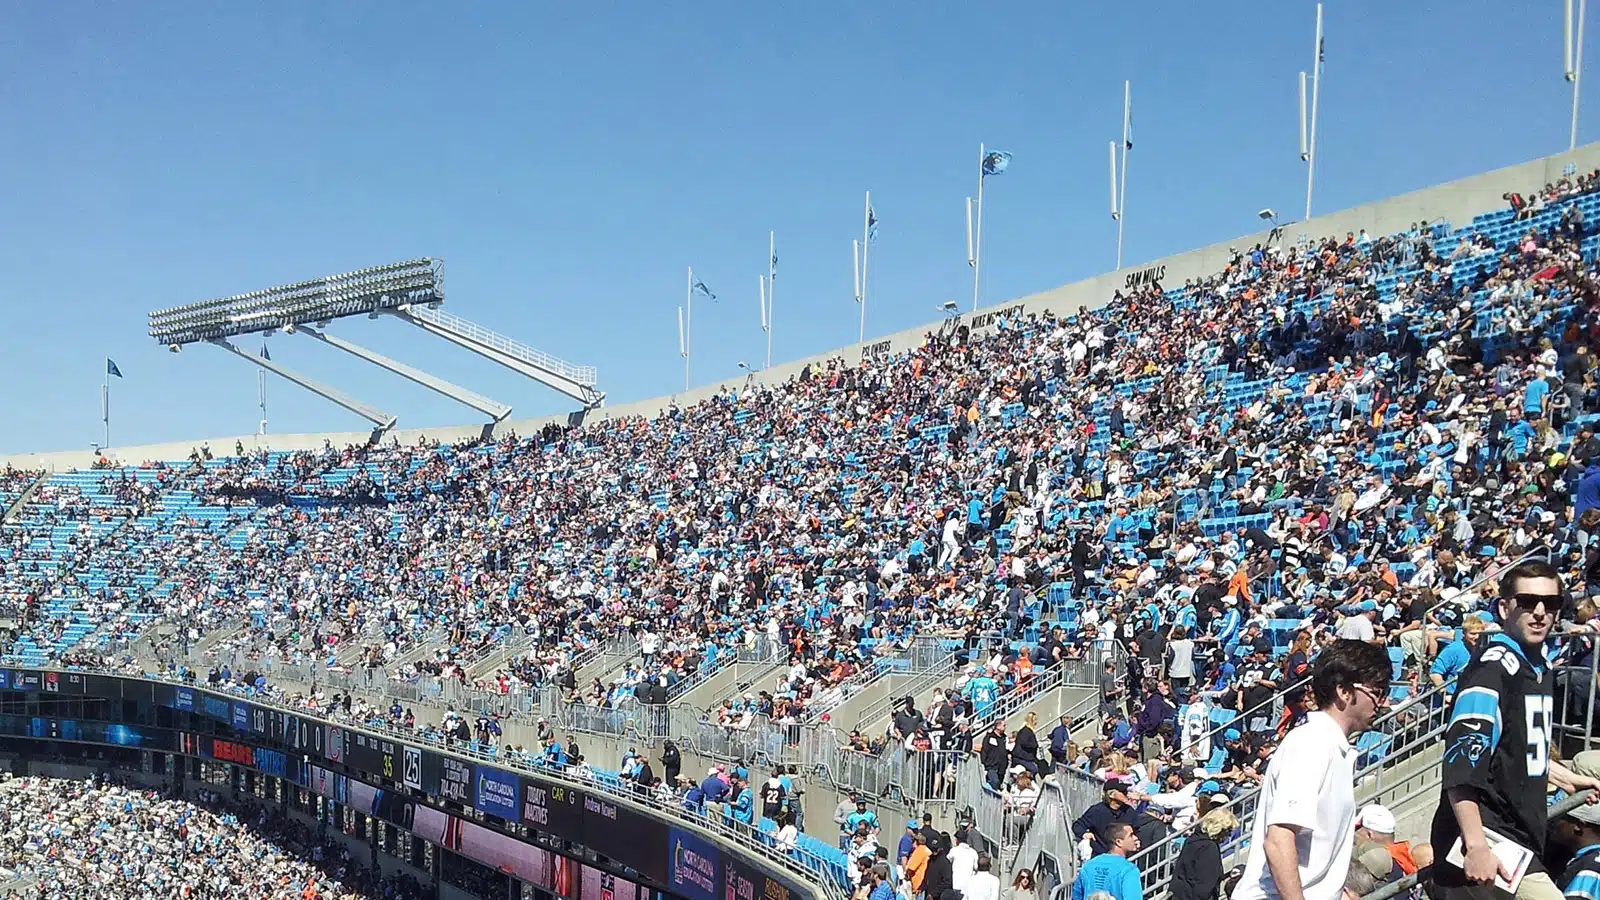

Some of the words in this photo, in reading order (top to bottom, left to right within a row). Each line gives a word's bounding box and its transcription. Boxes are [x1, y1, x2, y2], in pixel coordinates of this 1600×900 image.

[1125, 271, 1143, 289] SAM
[1143, 265, 1167, 284] MILLS
[971, 314, 987, 330] MIKE
[1480, 645, 1520, 676] 59
[253, 709, 265, 733] 1:03
[302, 722, 308, 748] 0
[314, 726, 321, 752] 0
[213, 739, 252, 766] BEARS
[383, 754, 393, 778] 35
[406, 751, 419, 783] 25
[485, 780, 499, 793] NORTH
[498, 783, 514, 798] CAROLINA
[526, 785, 546, 807] TODAY'S
[551, 786, 565, 802] CAR
[569, 791, 576, 805] G
[766, 789, 780, 804] 22
[501, 797, 514, 808] LOTTERY
[524, 802, 549, 826] INACTIVES
[583, 795, 602, 814] Andrew
